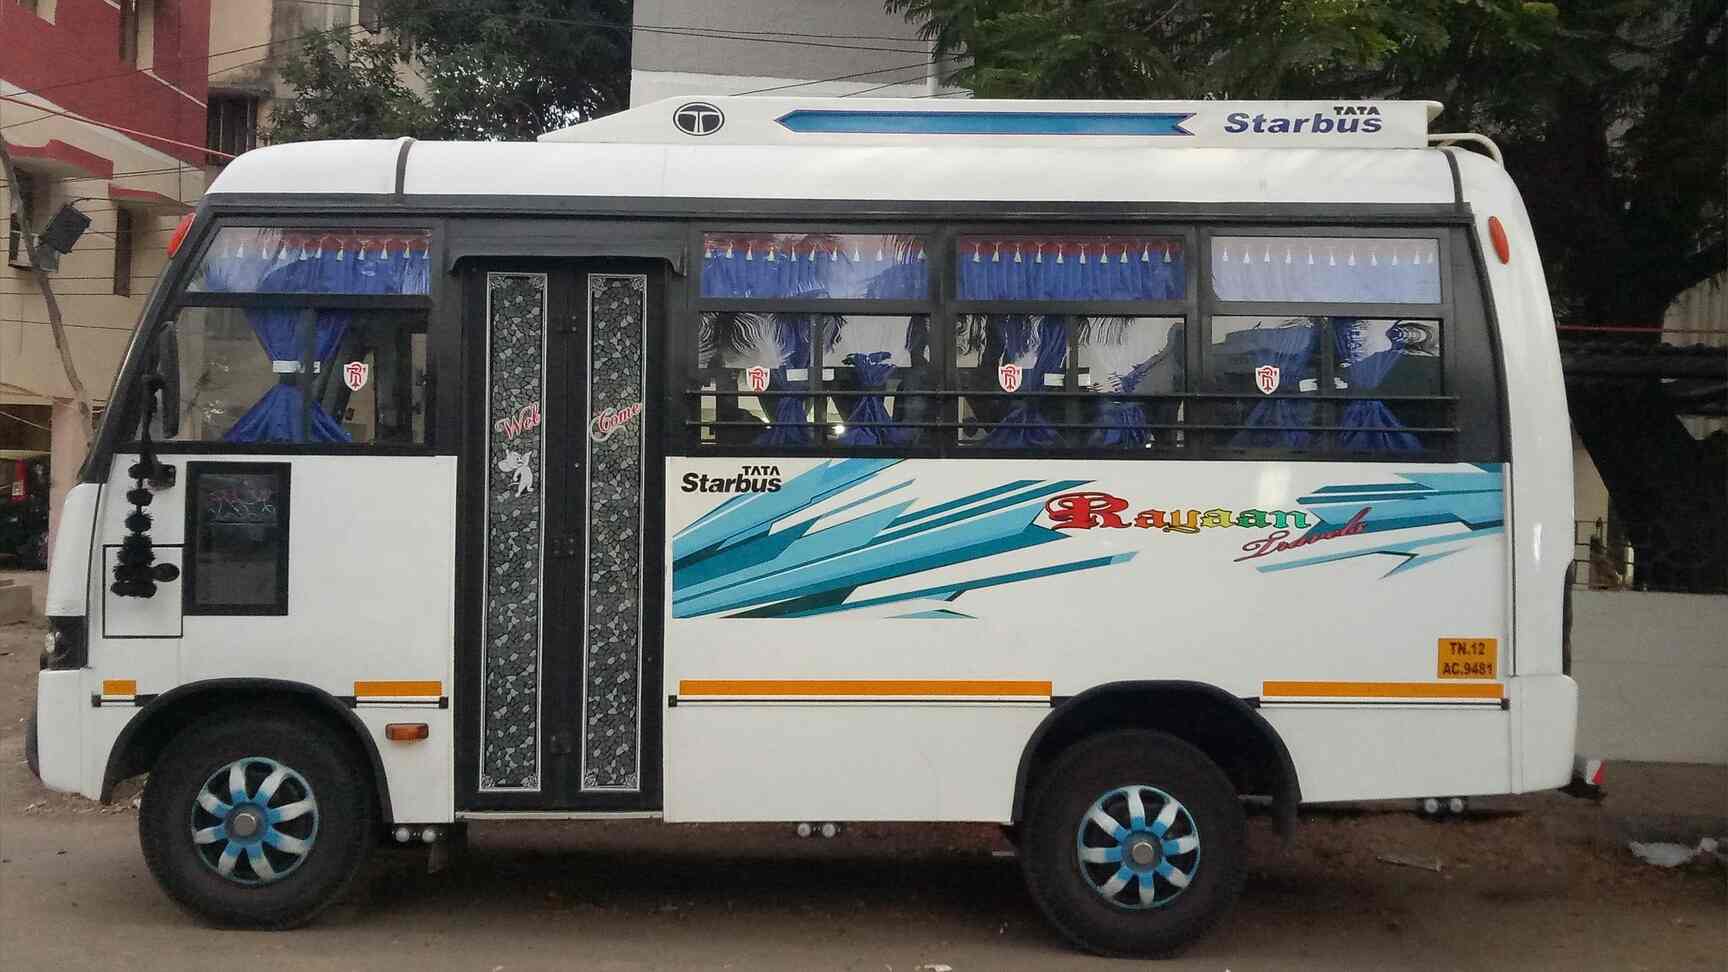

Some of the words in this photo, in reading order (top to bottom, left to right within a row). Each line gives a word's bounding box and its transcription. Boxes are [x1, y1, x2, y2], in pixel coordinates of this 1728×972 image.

[1333, 106, 1380, 115] TATA
[1224, 112, 1383, 133] Starbus
[591, 402, 643, 441] Come
[742, 465, 780, 476] TATA
[680, 472, 782, 493] Starbus
[1045, 492, 1311, 533] Rayaan
